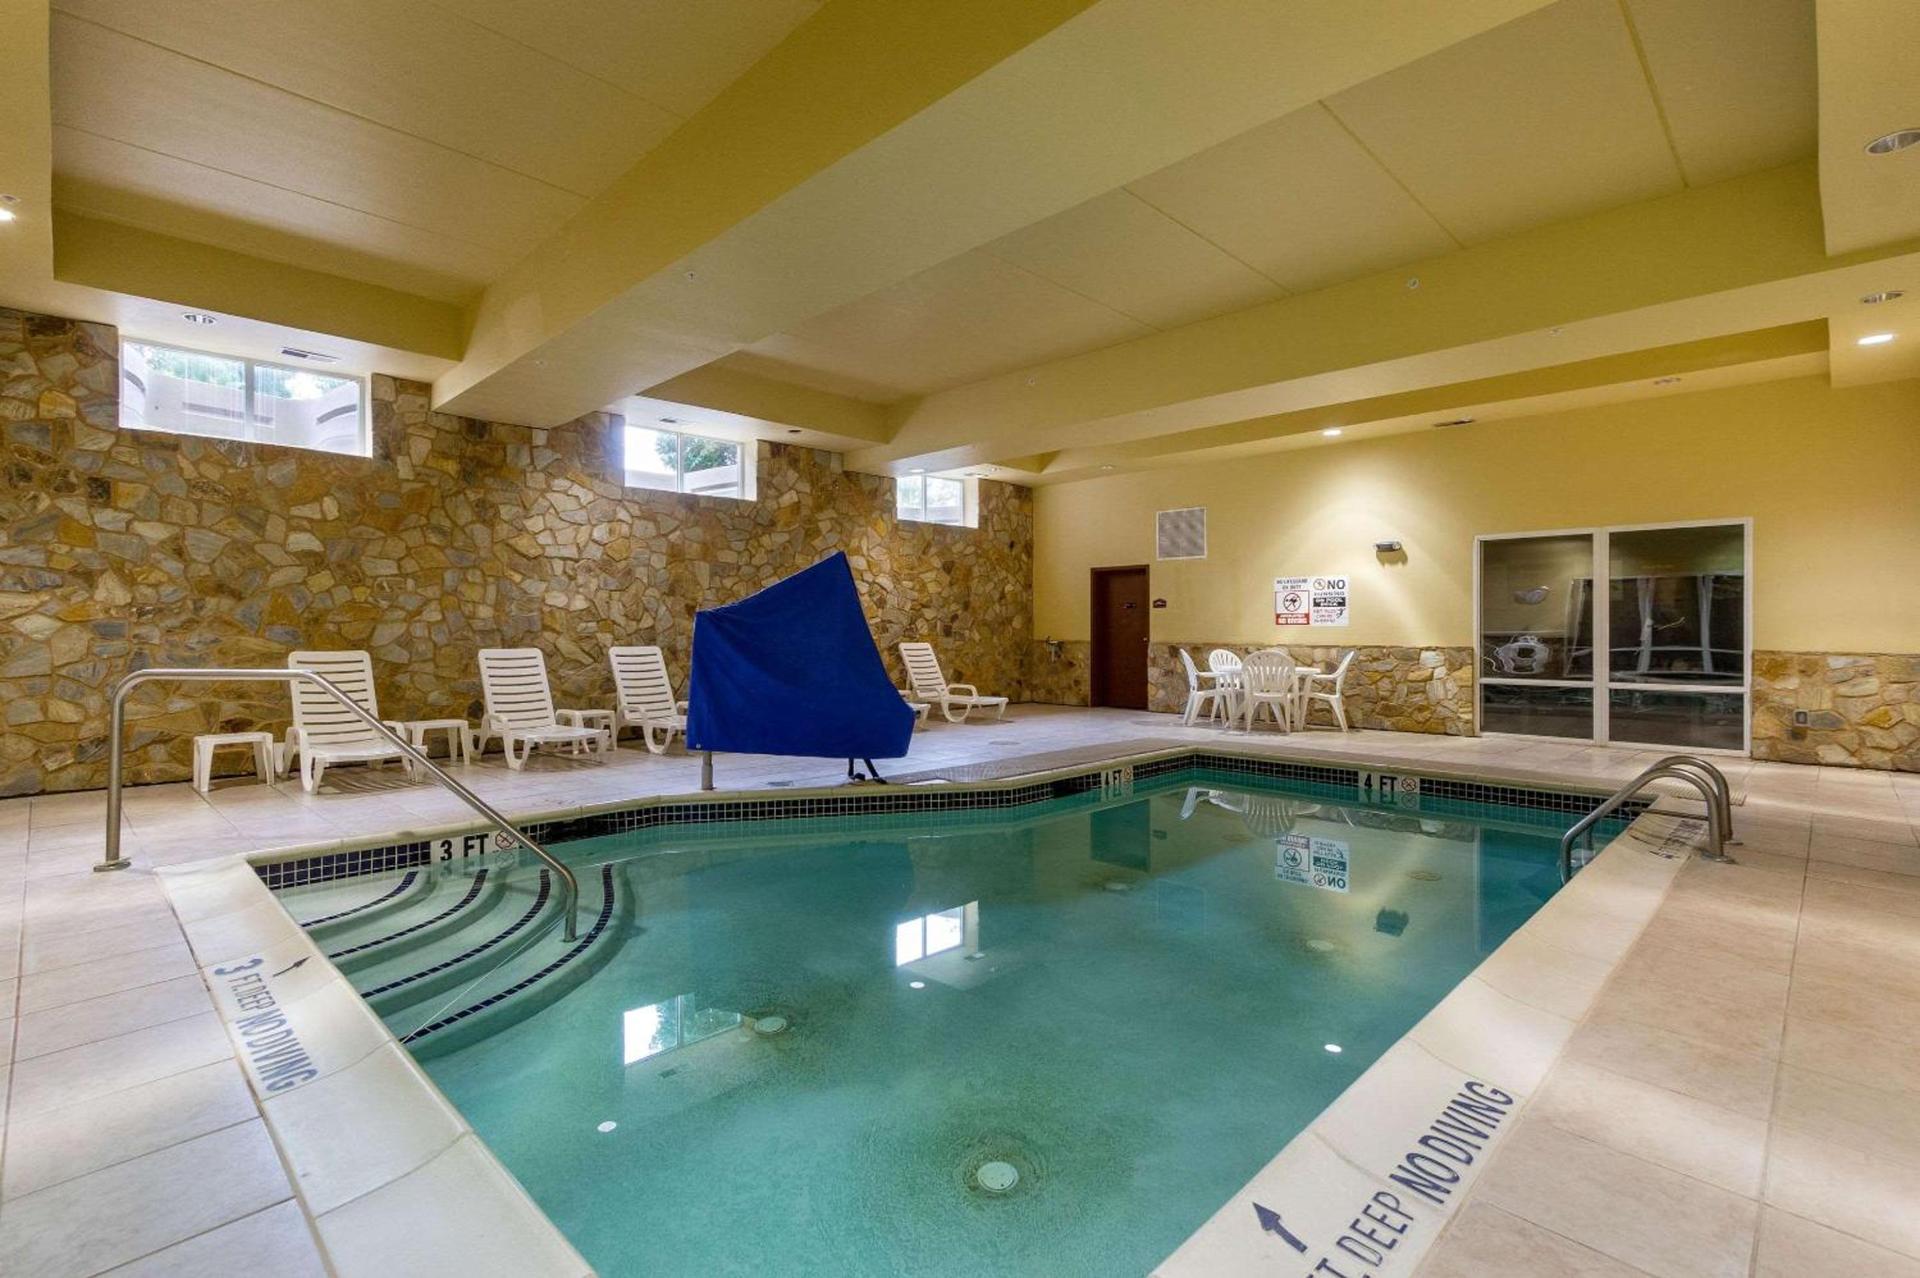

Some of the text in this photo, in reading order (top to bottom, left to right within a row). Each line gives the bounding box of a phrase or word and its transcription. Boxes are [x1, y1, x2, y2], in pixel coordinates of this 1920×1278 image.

[1327, 579, 1346, 590] NO
[1113, 769, 1122, 785] FT
[1364, 773, 1398, 792] 4 FT
[440, 833, 489, 861] 3 FT
[214, 958, 263, 975] 3
[235, 985, 276, 1012] DEEP
[1418, 1081, 1513, 1165] DIVING
[1389, 1152, 1460, 1204] NO
[1336, 1191, 1414, 1267] DEEP
